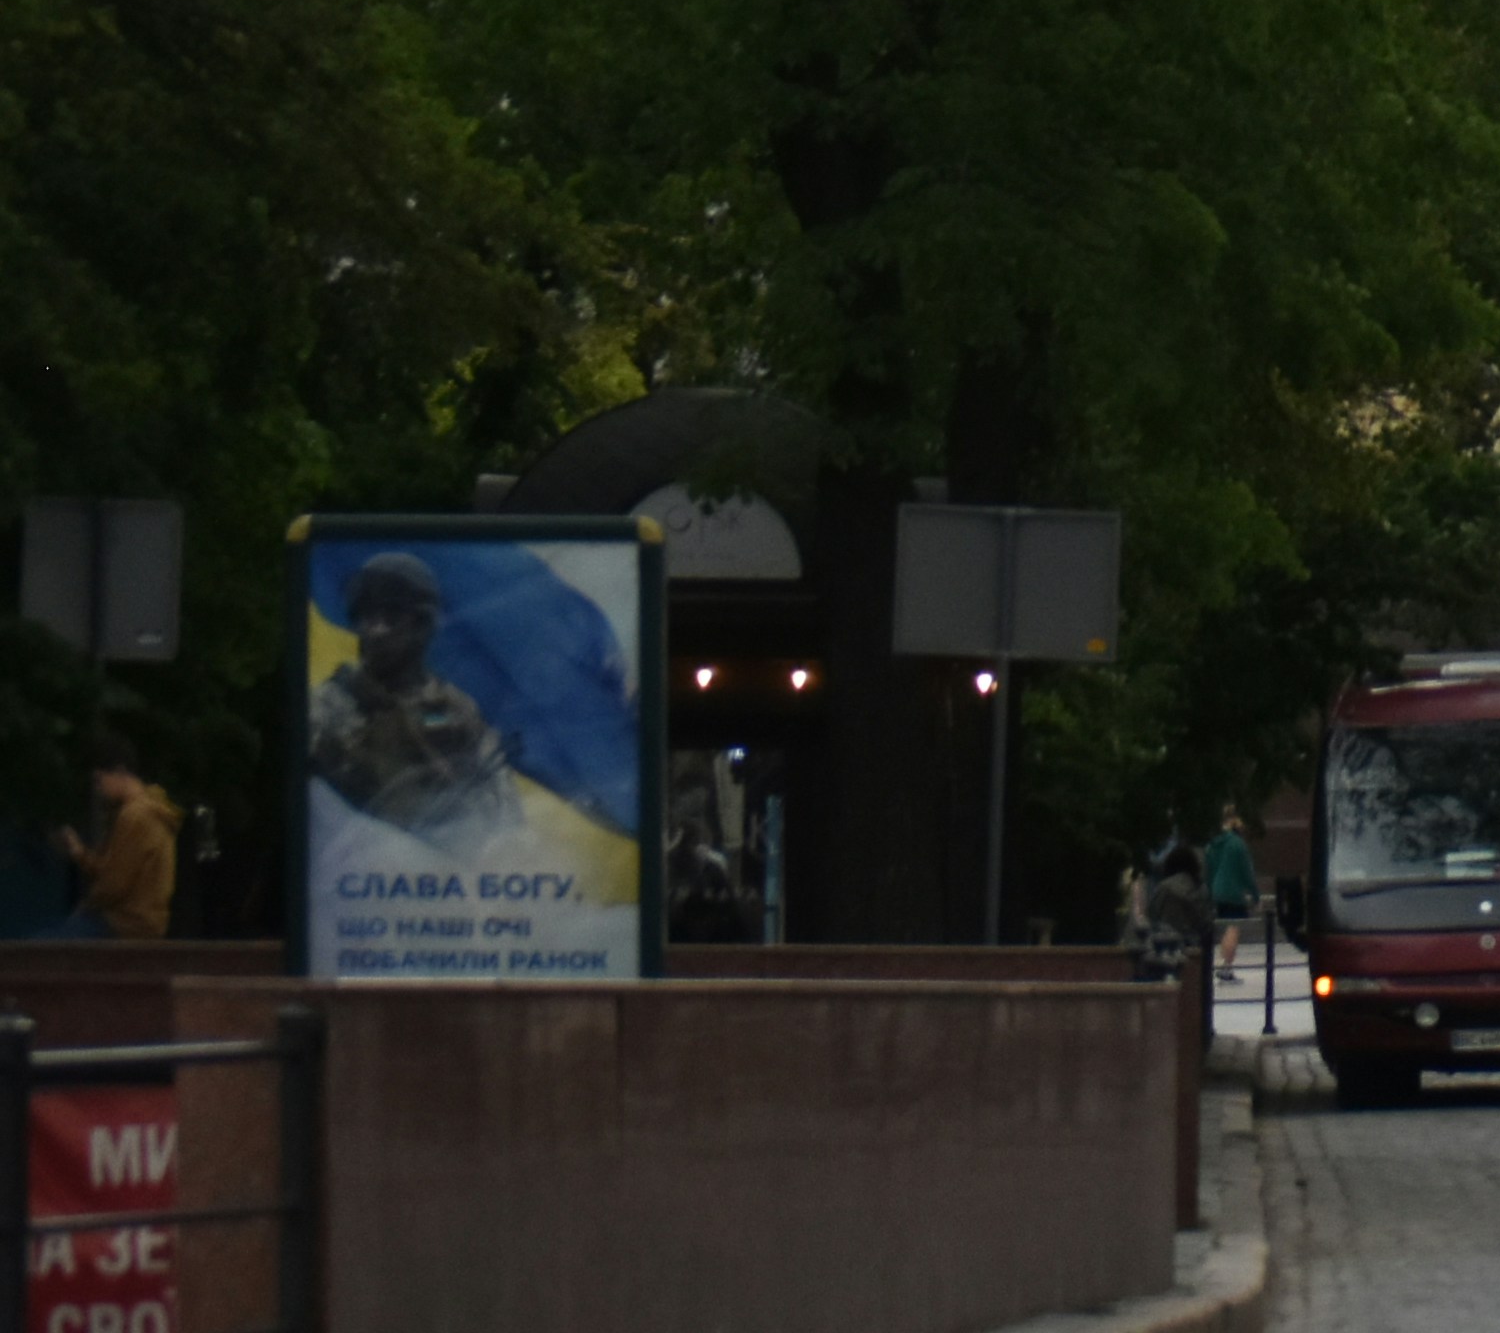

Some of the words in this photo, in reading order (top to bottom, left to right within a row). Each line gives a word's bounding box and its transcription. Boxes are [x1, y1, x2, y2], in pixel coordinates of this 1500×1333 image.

[337, 872, 467, 900] СЛАВА
[337, 916, 389, 937] ЩО
[396, 915, 474, 937] НАШІ
[482, 916, 532, 937] ОЧІ
[337, 948, 500, 972] ПОБАЧИЛИ
[508, 948, 607, 971] РАНОК
